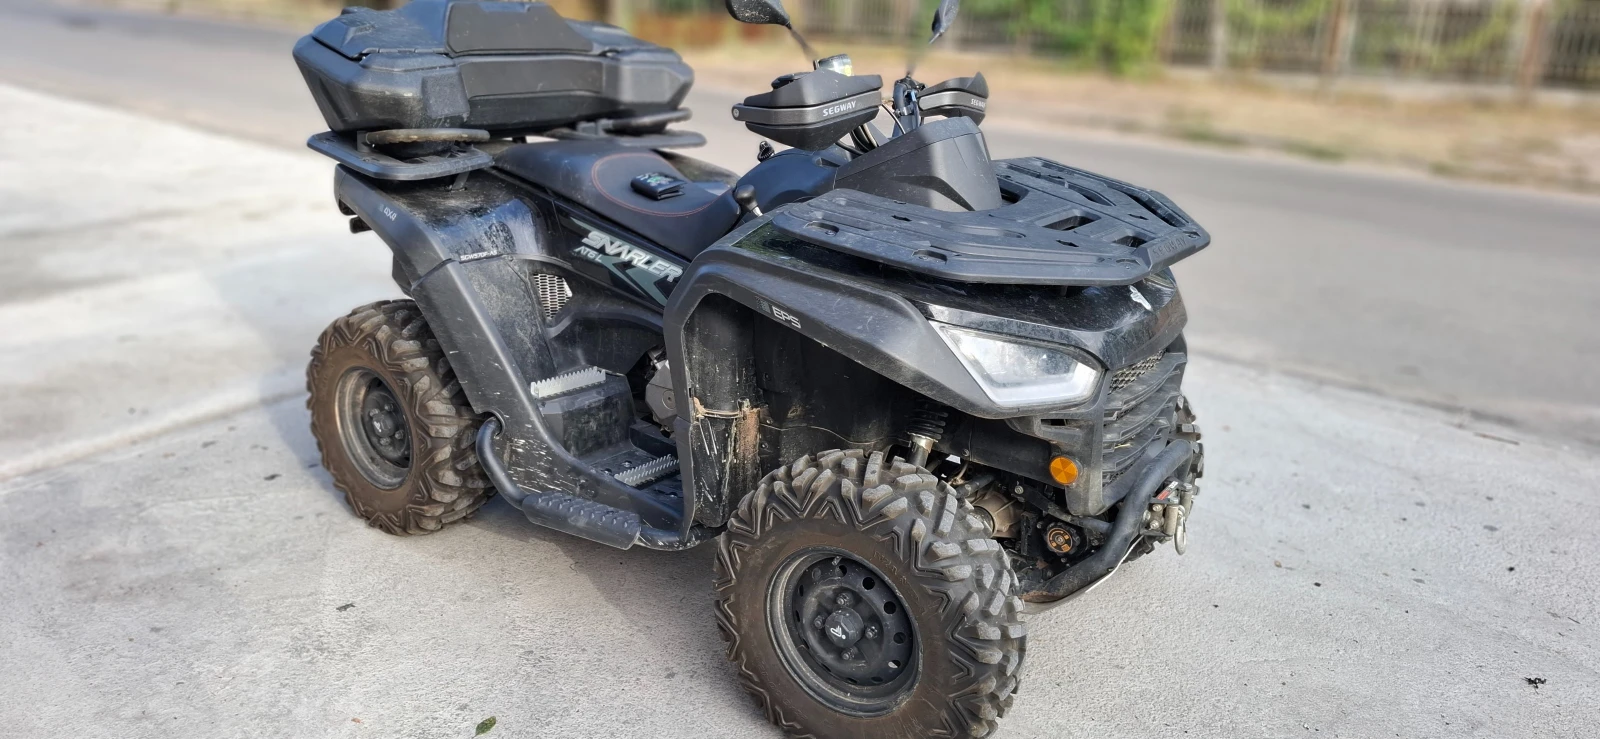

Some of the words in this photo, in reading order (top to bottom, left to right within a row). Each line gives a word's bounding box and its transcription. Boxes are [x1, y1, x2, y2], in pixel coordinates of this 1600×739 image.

[822, 100, 857, 117] SEGWAY
[573, 245, 598, 258] AT6
[582, 230, 683, 282] SNARLER
[771, 305, 802, 329] EPS
